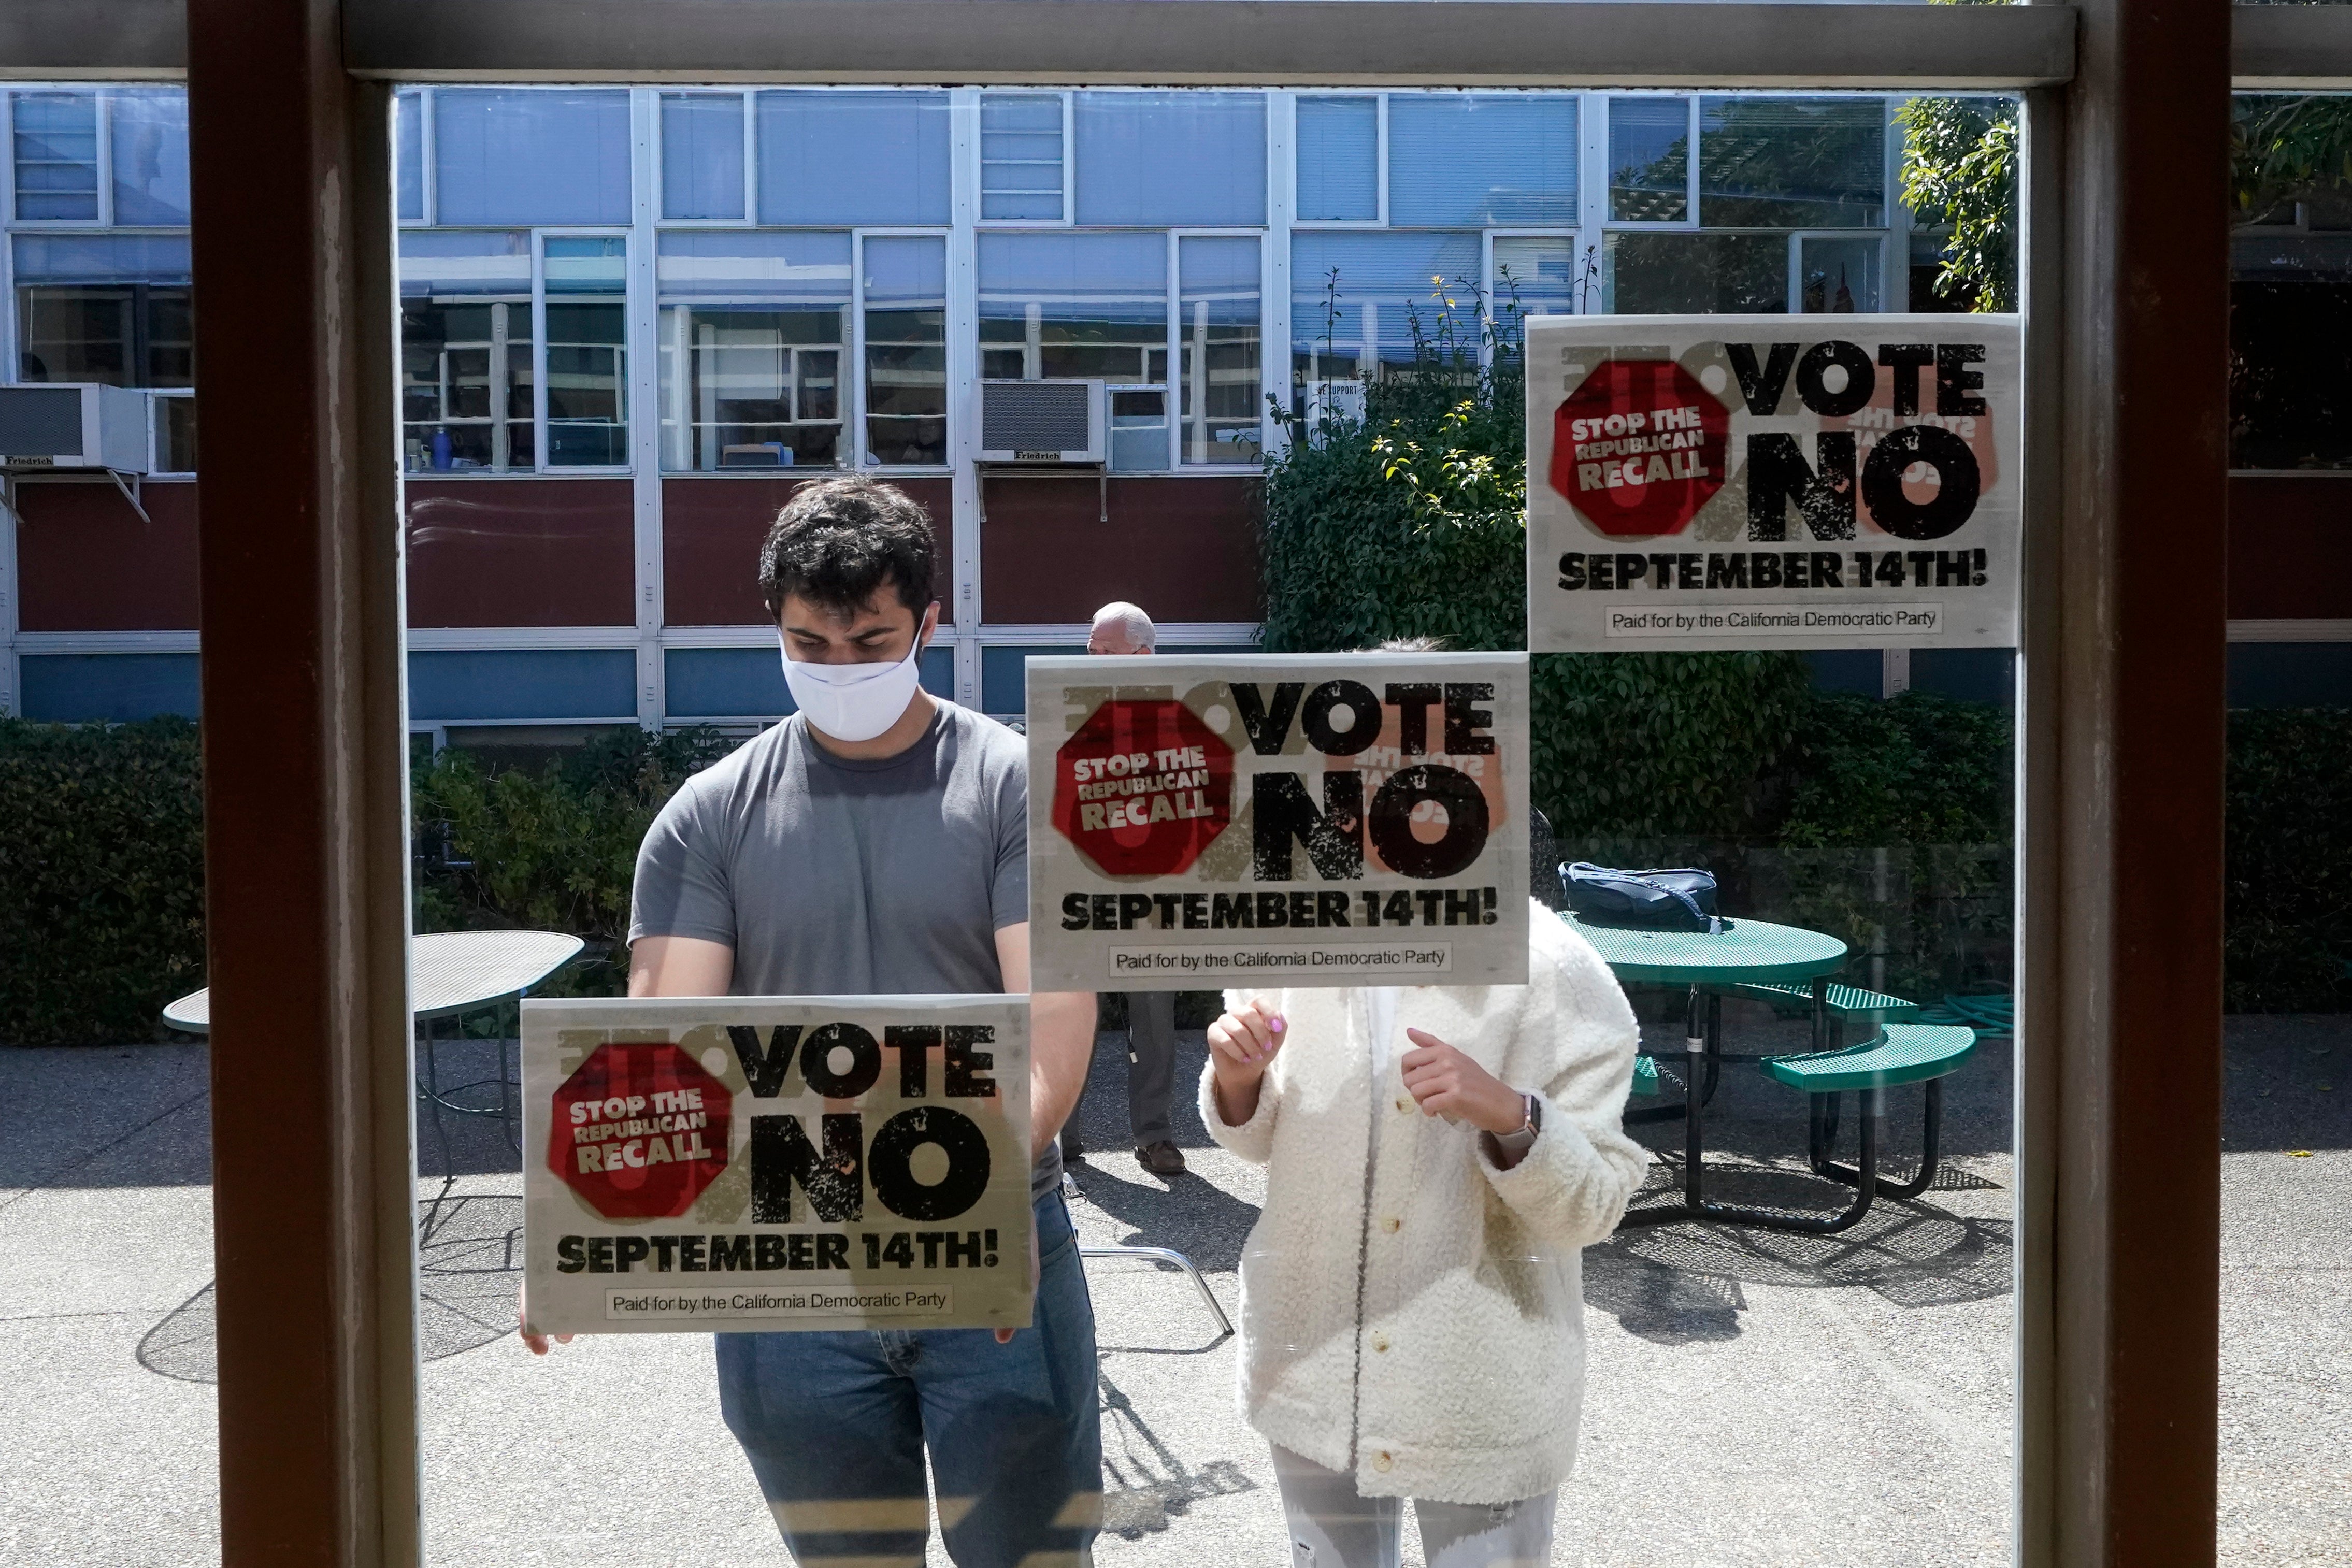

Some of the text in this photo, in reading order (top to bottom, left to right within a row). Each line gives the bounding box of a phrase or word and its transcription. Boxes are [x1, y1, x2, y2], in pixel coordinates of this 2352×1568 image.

[1725, 340, 1987, 416] VOTE
[1571, 406, 1701, 441] STOP THE
[6, 456, 52, 465] Friedrich
[1016, 451, 1059, 459] Friedrich
[1575, 429, 1704, 461] REPUBLICAN
[1577, 450, 1709, 491] RECALL
[1747, 425, 1980, 541] NO
[1557, 548, 1988, 591] SEPTEMBER 14TH!
[1613, 611, 1935, 630] Paid for by the California Democratic Party
[1228, 680, 1495, 756] VOTE
[1074, 745, 1206, 781] STOP THE
[1078, 769, 1209, 801] REPUBLICAN
[1081, 789, 1214, 831] RECALL
[1252, 764, 1489, 882] NO
[1060, 886, 1498, 931] SEPTEMBER 14TH!
[1116, 950, 1445, 970] Paid for by the California Democratic Party
[726, 1022, 997, 1099] VOTE
[570, 1088, 703, 1124] STOP THE
[574, 1111, 707, 1143] REPUBLICAN
[577, 1132, 712, 1174] RECALL
[750, 1106, 991, 1224] NO
[556, 1229, 999, 1273] SEPTEMBER 14TH!
[613, 1293, 945, 1313] Paid for by the California Democratic Party
